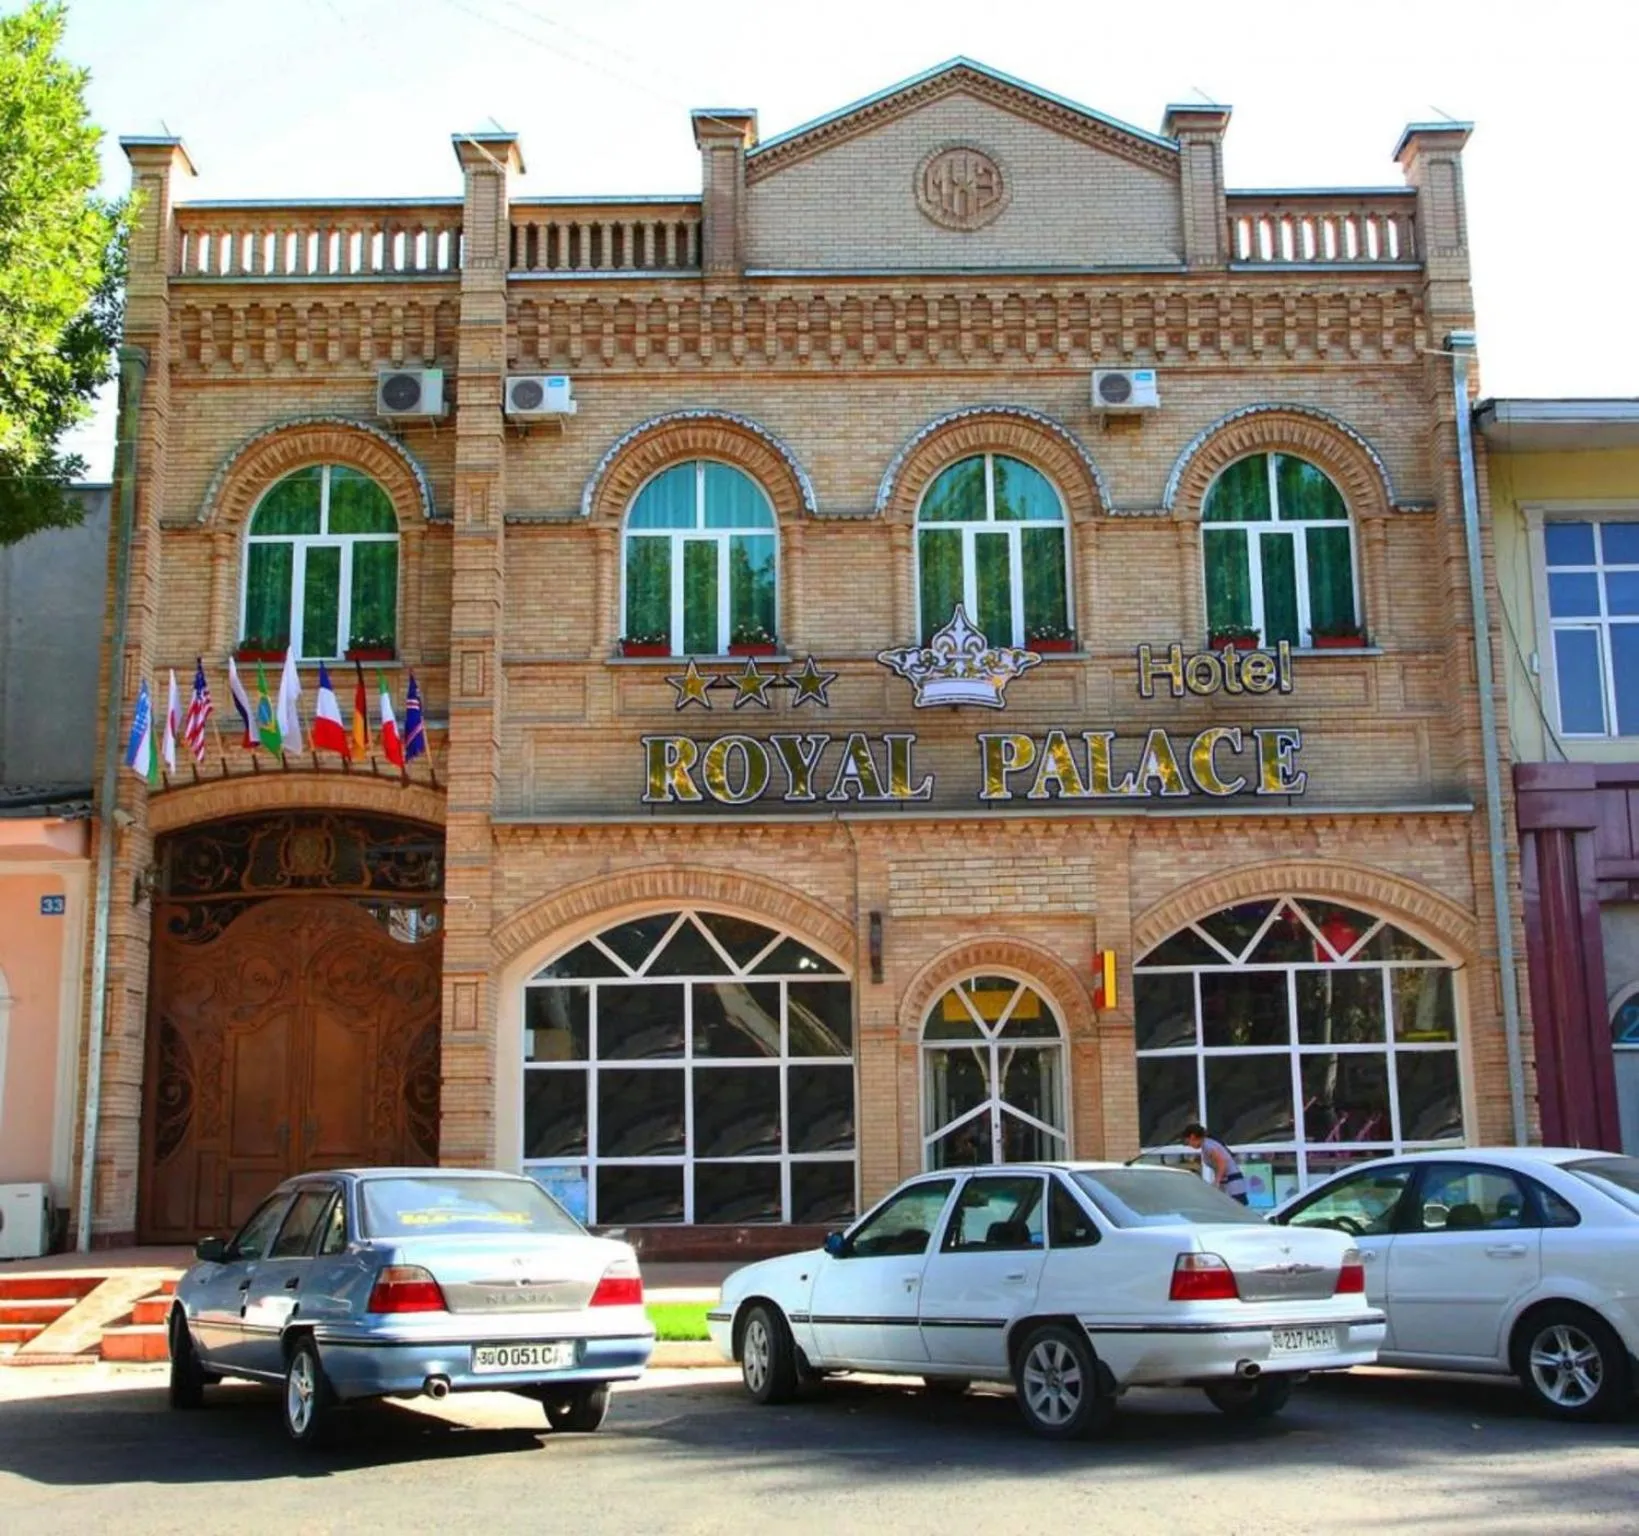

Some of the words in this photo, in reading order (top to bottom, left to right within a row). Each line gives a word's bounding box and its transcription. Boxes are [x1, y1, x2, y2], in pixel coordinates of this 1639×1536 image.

[1137, 639, 1294, 697] Hotel
[641, 732, 935, 805] ROYAL
[977, 726, 1308, 800] PALACE
[43, 898, 63, 912] 33
